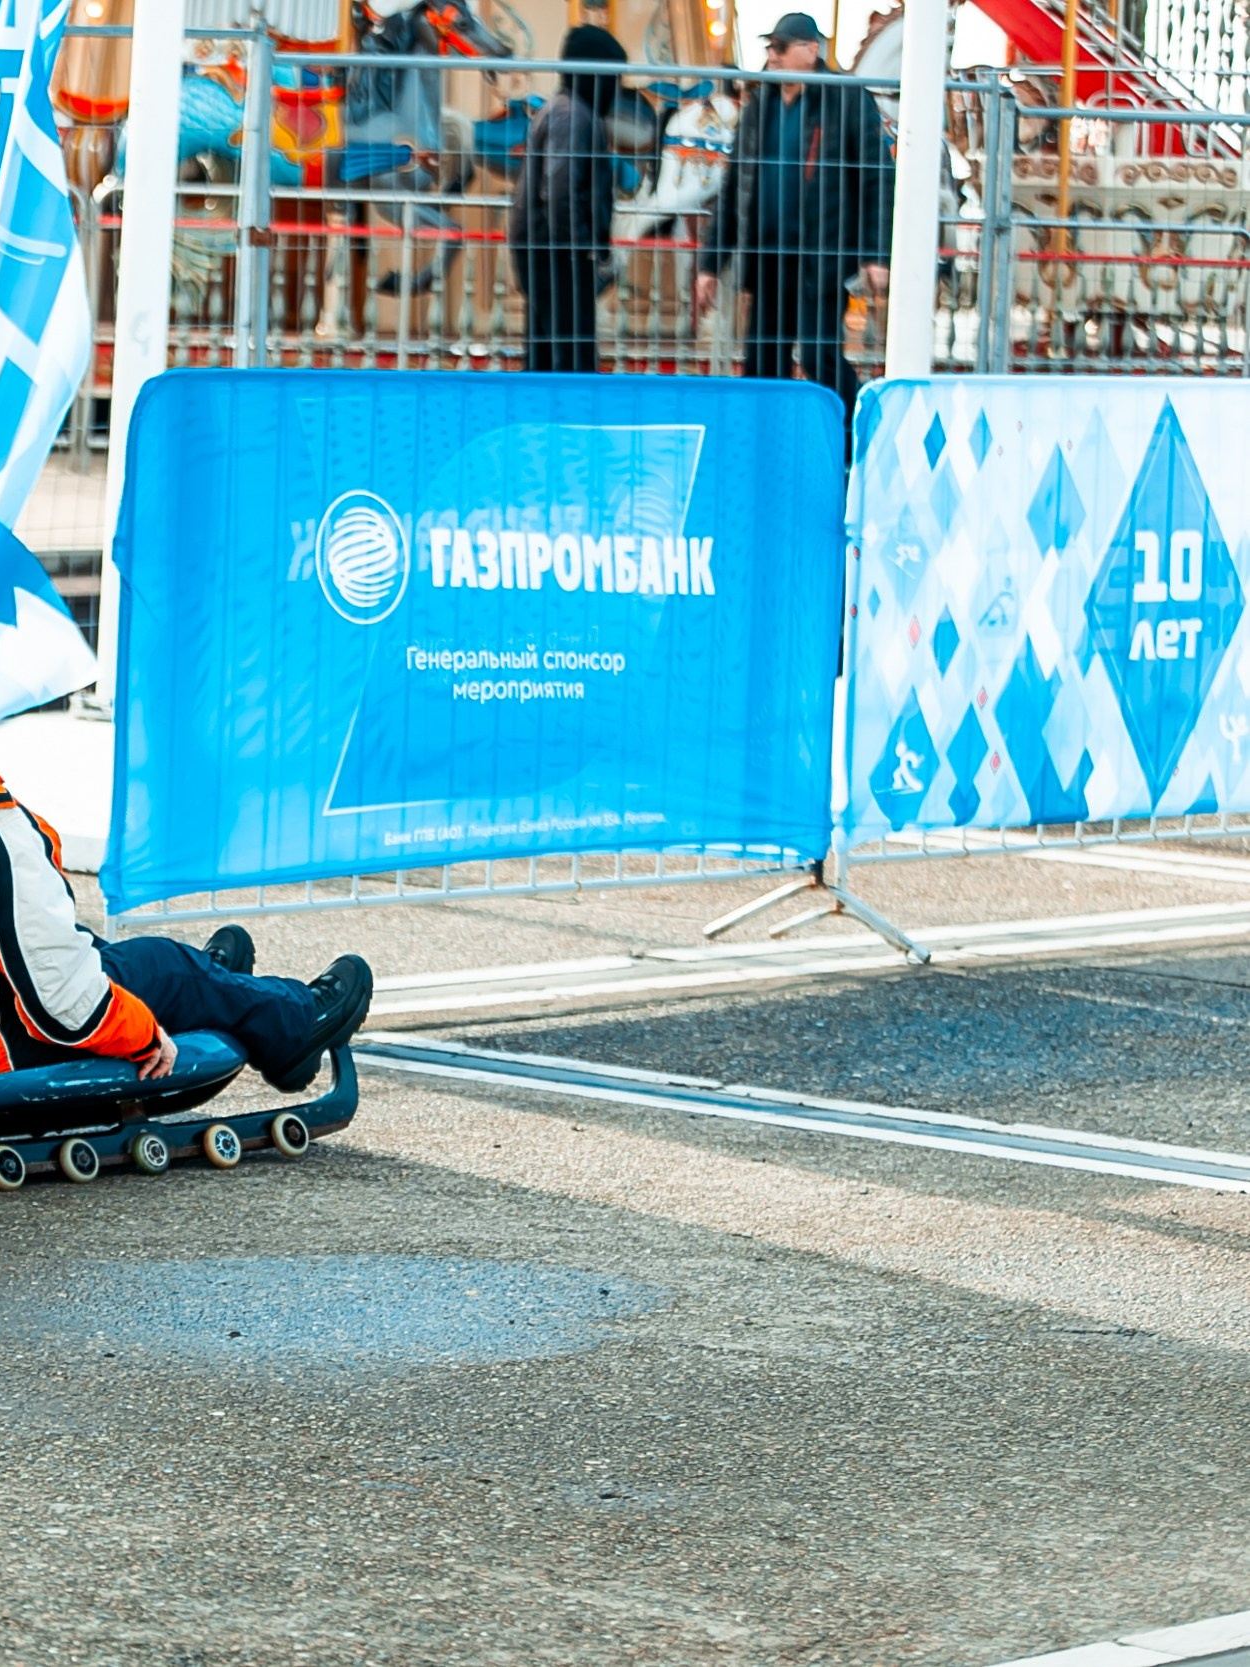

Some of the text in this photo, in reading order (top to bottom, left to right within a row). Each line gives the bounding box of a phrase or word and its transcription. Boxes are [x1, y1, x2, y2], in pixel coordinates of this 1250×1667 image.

[430, 528, 716, 596] ГАЗПРОМБАНК
[1133, 529, 1204, 603] 10
[406, 643, 626, 676] Генеральный спонсор
[1128, 617, 1203, 661] лет
[453, 679, 585, 704] мероприятия
